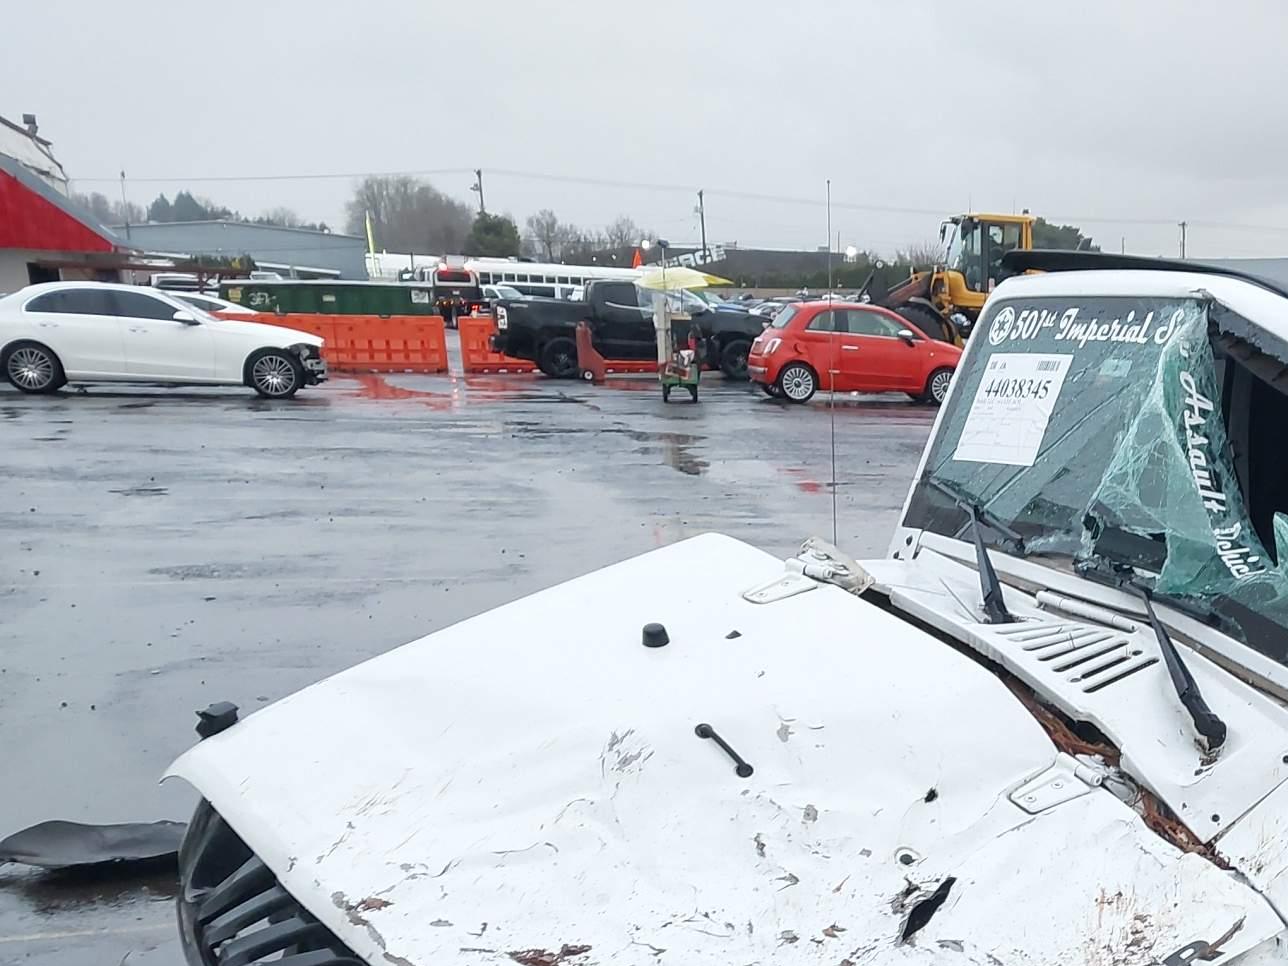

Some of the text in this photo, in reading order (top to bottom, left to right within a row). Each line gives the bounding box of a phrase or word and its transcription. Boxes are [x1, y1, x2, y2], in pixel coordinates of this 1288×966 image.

[1010, 309, 1058, 341] 501st
[1055, 307, 1154, 348] Imperial
[984, 378, 1053, 400] 44038345
[1179, 371, 1268, 579] Assault Vehicl
